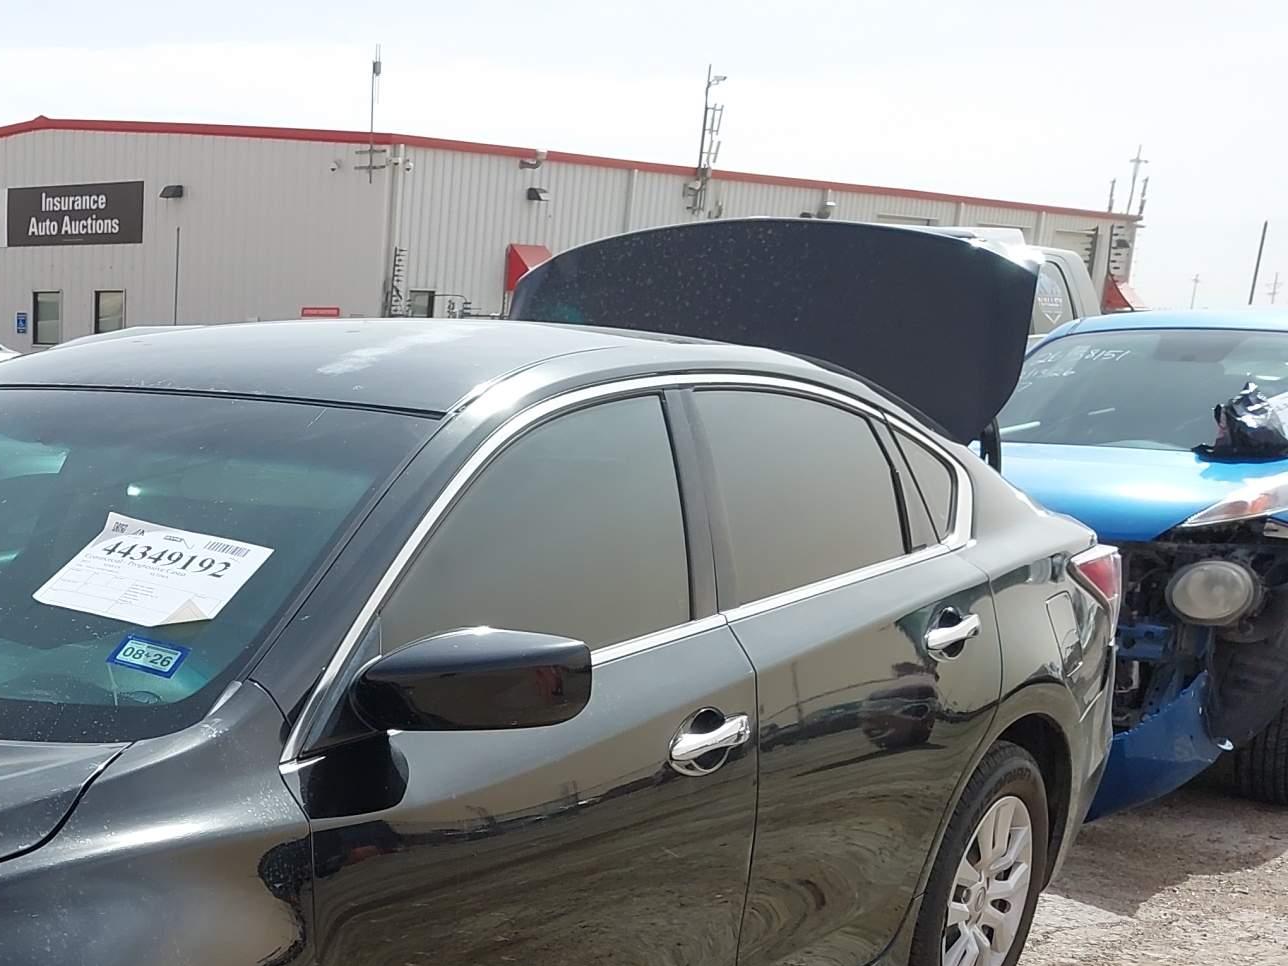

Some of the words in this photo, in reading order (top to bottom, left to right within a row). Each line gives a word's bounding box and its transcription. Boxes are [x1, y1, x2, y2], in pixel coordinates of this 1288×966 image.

[41, 193, 107, 212] Insurance
[28, 216, 58, 236] Auto
[61, 214, 120, 234] Auctions
[102, 541, 231, 578] 44349192
